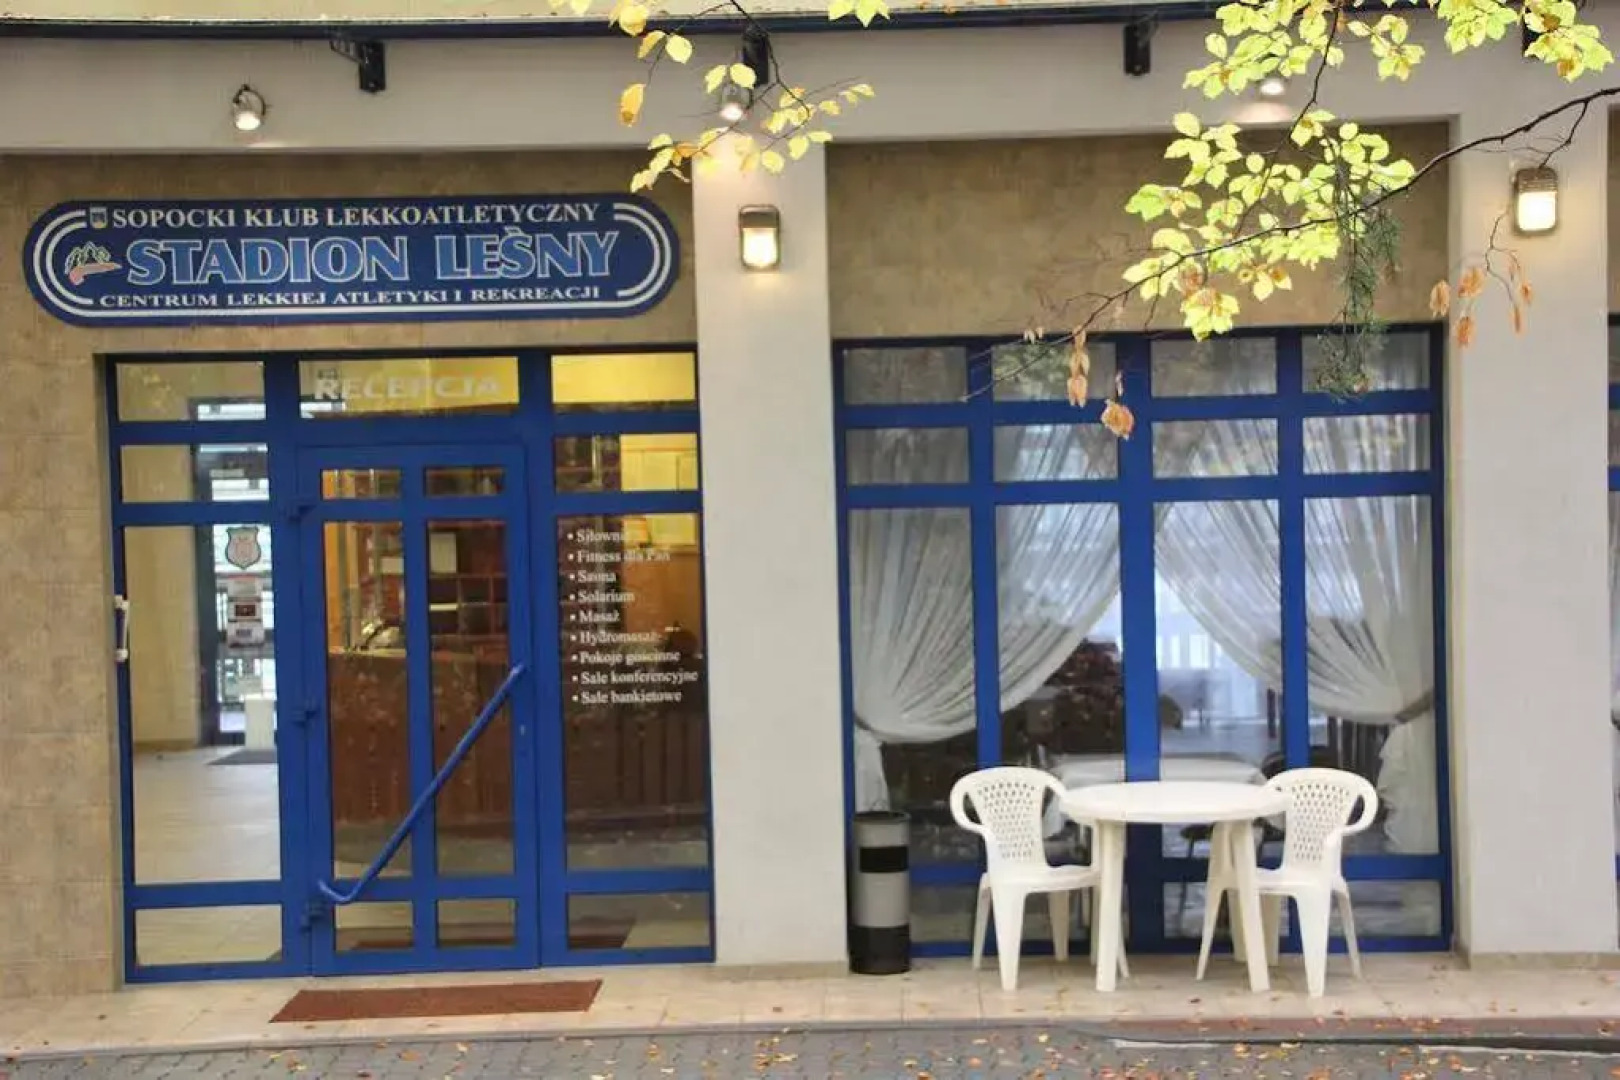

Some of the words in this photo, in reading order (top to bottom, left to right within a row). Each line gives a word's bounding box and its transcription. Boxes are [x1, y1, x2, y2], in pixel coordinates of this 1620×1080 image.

[112, 207, 236, 228] SOPOCKI
[245, 207, 319, 227] KLUB
[327, 203, 599, 226] LEKKOATLETYCZNY
[126, 237, 411, 286] STADION
[434, 225, 620, 281] LEŚNY
[100, 293, 218, 308] CENTRUM
[226, 292, 327, 307] LEKKIEJ
[332, 289, 448, 304] ATLETYKI
[453, 288, 461, 303] I
[470, 286, 600, 302] REKREACJI
[314, 374, 500, 400] RECEPCJA
[577, 550, 621, 563] Fitness
[577, 570, 617, 583] Sauna
[577, 589, 636, 603] Solarium
[580, 651, 623, 665] Pokoje
[580, 671, 608, 684] Sale
[610, 669, 699, 685] konferencyjne
[580, 690, 609, 704] Sale
[610, 688, 682, 704] bankietowe
